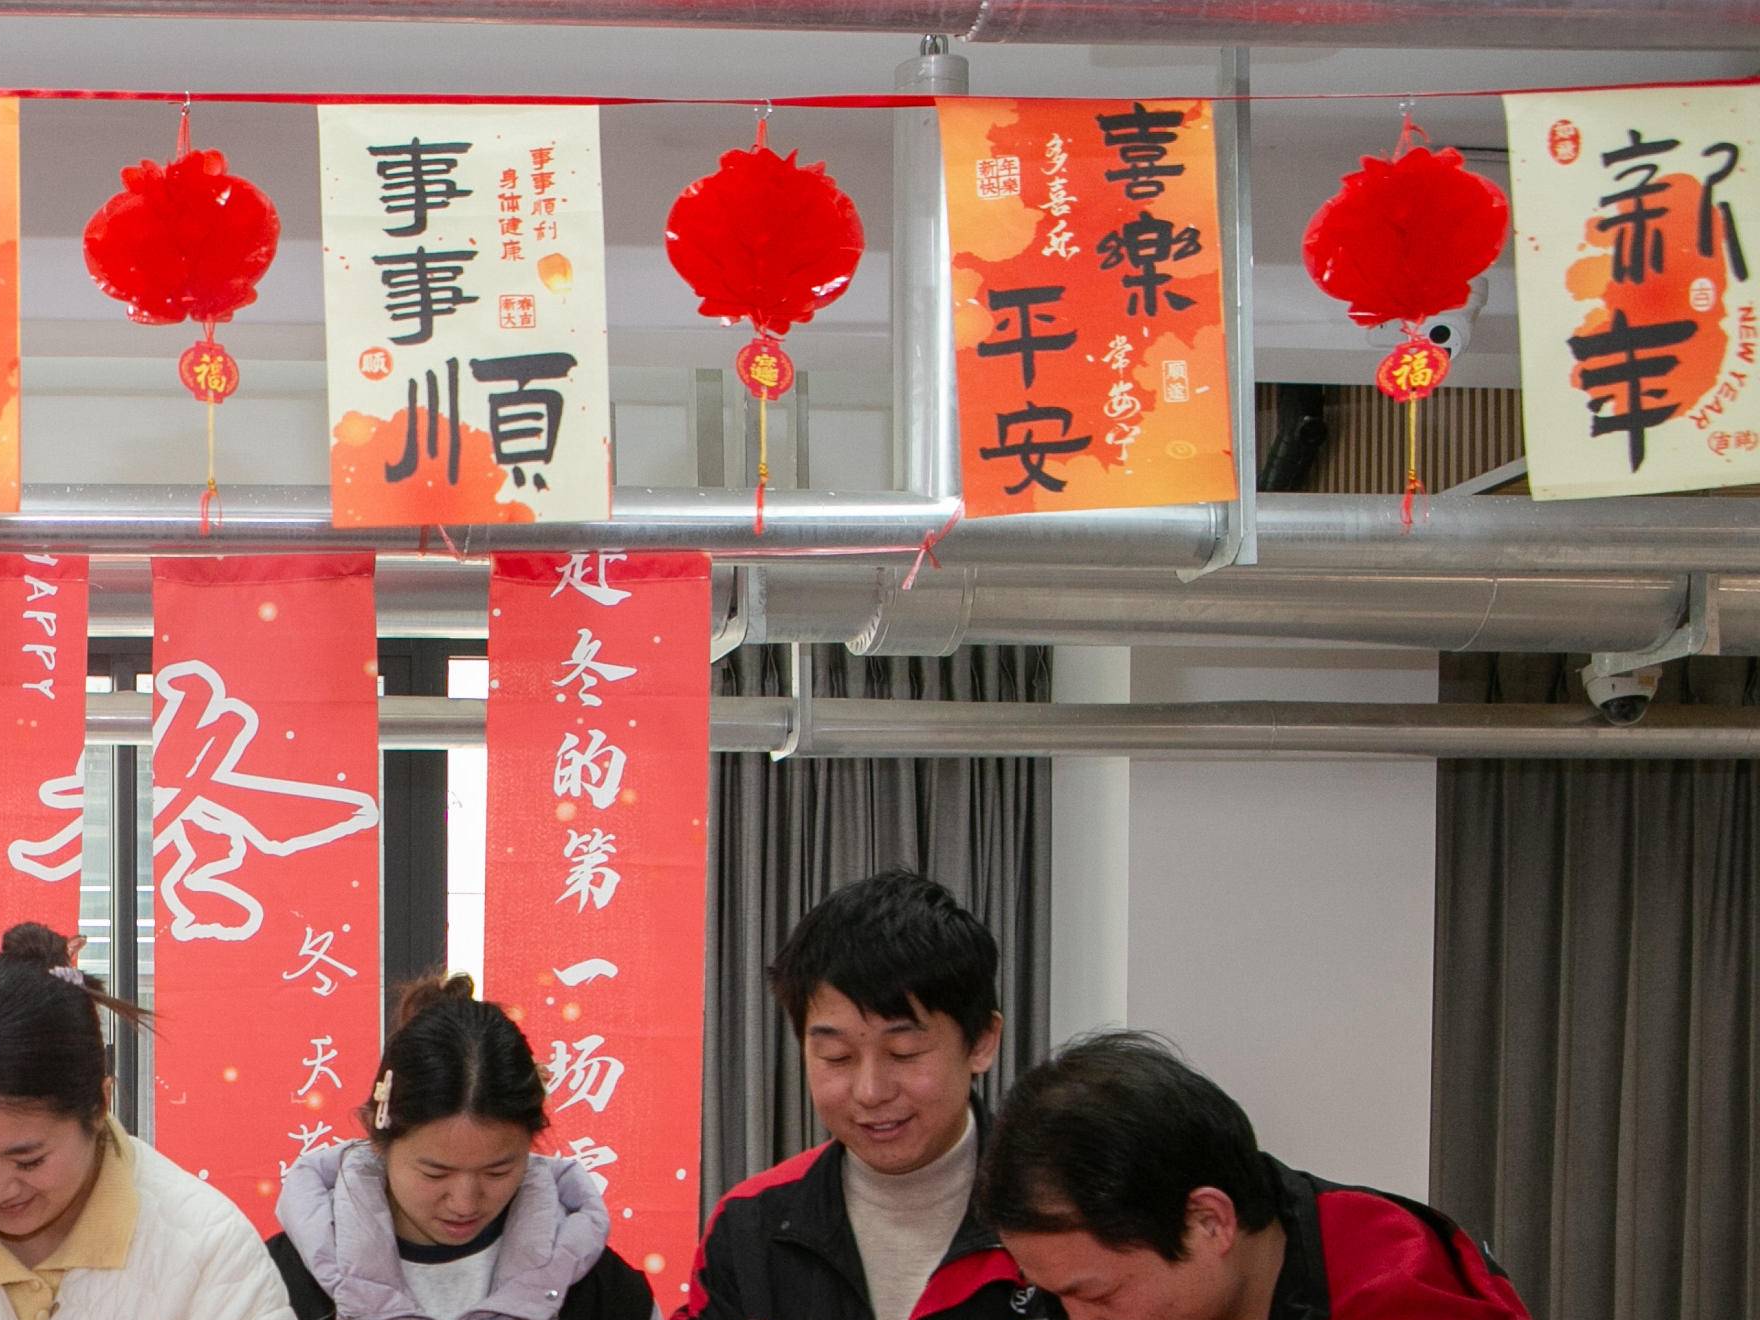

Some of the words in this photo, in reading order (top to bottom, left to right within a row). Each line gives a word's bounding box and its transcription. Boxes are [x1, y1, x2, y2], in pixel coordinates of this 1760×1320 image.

[497, 168, 525, 262] 身体健康
[1095, 102, 1202, 317] 喜樂
[1567, 129, 1748, 473] 新年
[1737, 307, 1757, 364] NEW
[194, 354, 226, 393] 福
[977, 285, 1094, 496] 平安
[1392, 351, 1433, 391] 福
[1690, 370, 1745, 430] YEAR
